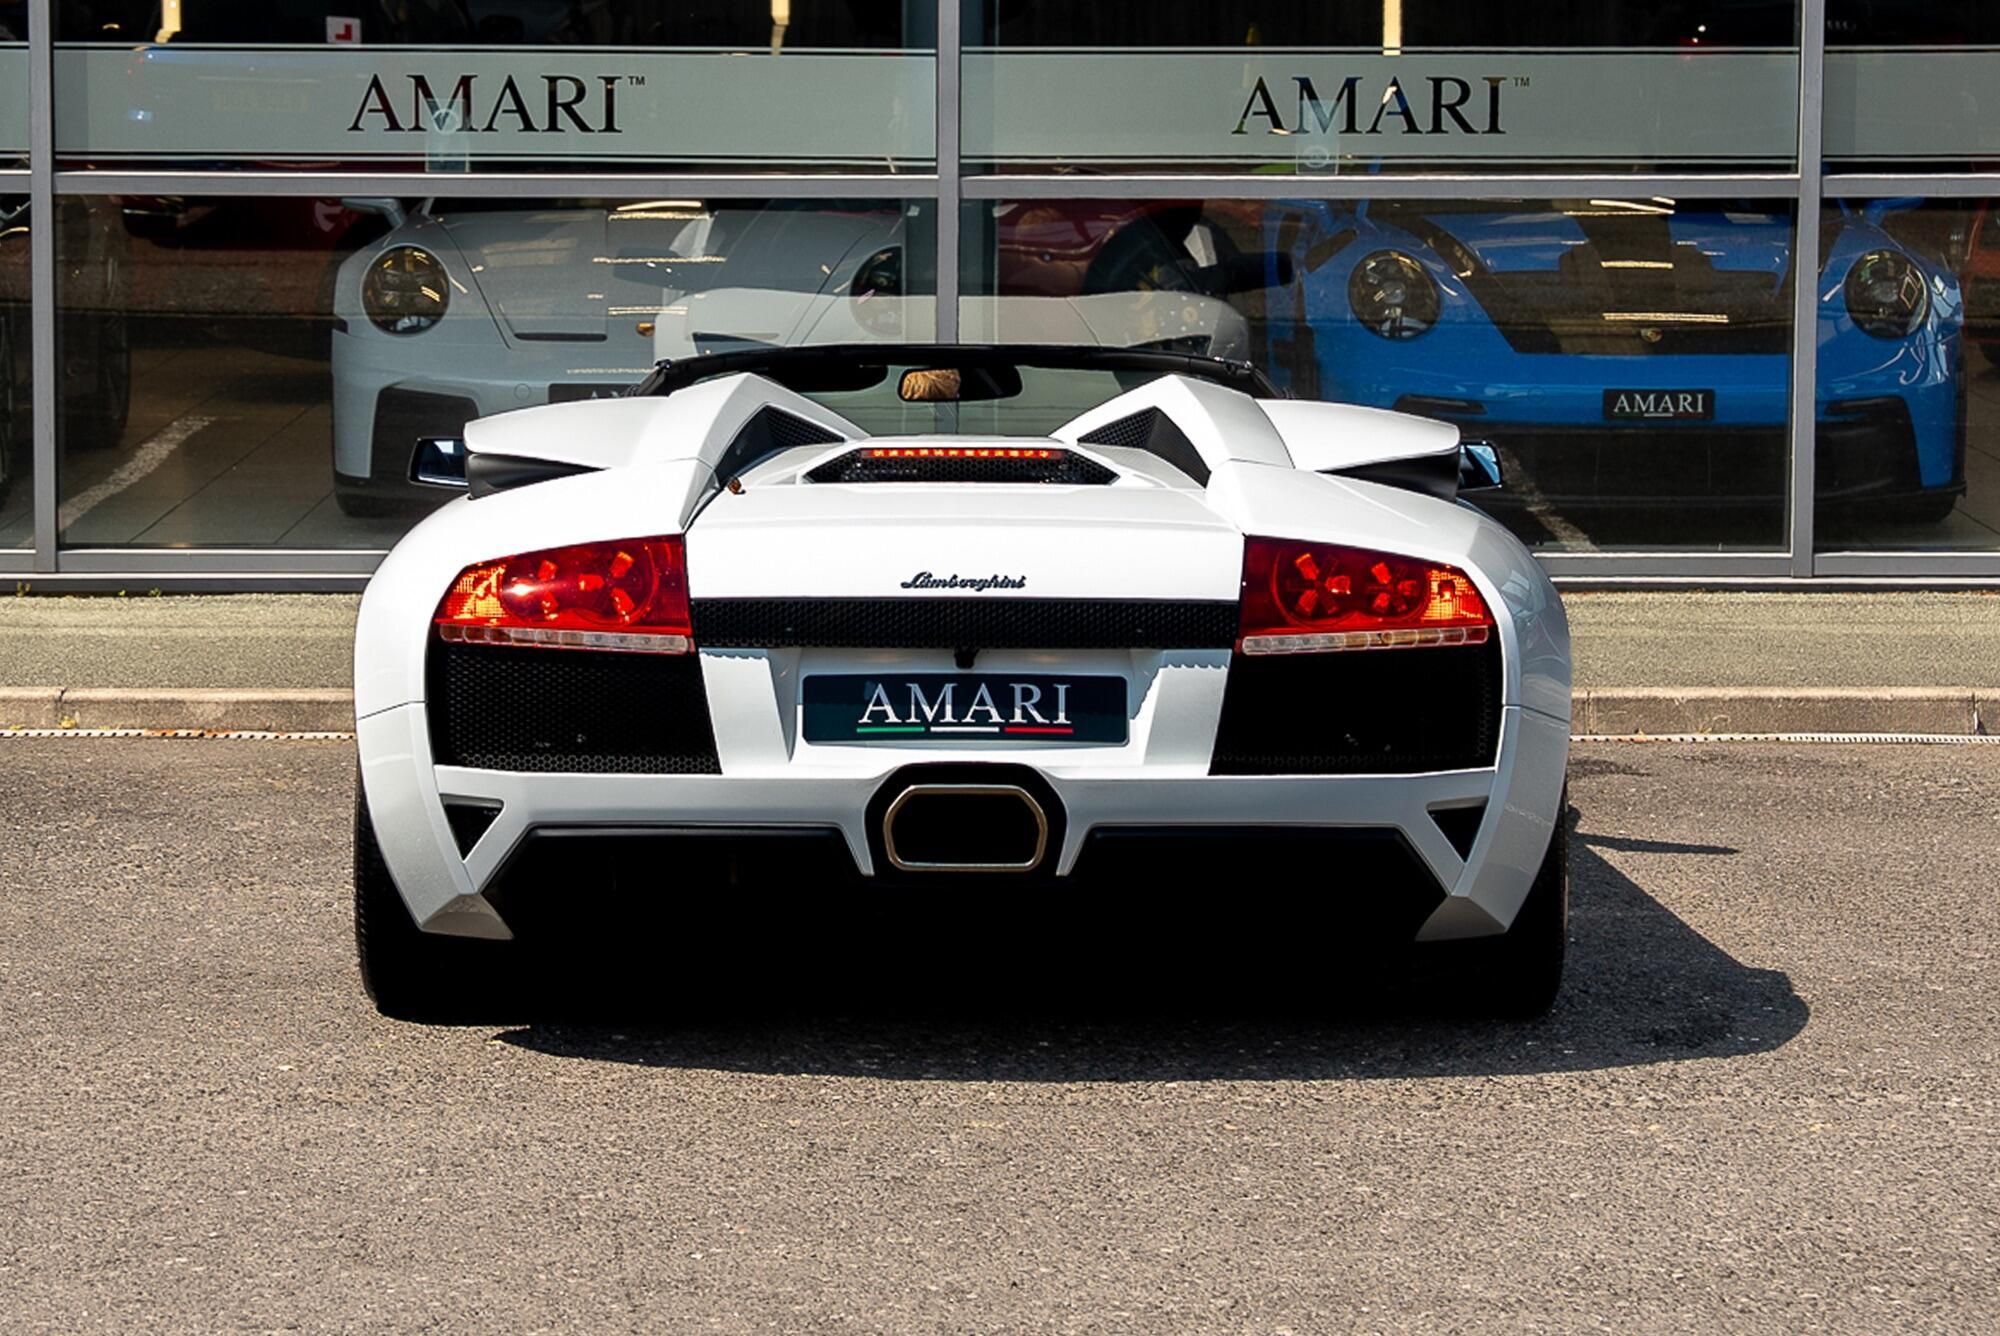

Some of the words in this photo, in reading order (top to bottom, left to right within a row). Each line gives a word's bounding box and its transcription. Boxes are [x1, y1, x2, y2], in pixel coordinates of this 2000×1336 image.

[347, 73, 623, 133] AMARI
[1231, 76, 1507, 135] AMARI
[1613, 393, 1705, 413] AMARI
[900, 571, 1027, 592] Lamborghini
[858, 682, 1072, 725] AMARI
